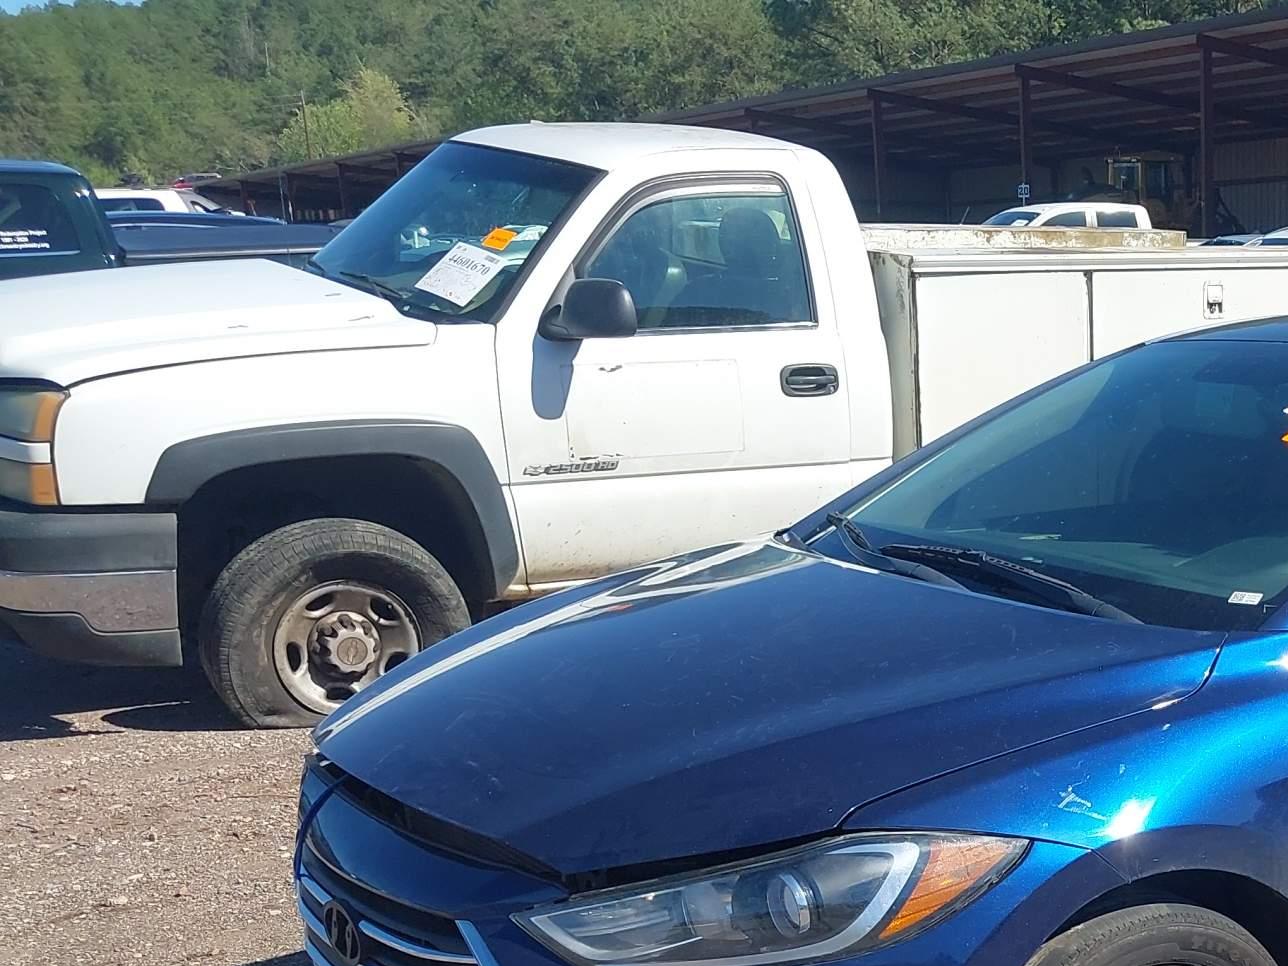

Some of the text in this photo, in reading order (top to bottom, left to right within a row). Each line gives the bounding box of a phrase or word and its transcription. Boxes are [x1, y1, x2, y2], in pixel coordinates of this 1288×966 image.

[1018, 186, 1029, 196] 20
[447, 253, 491, 276] 44601670
[545, 461, 596, 475] 2500
